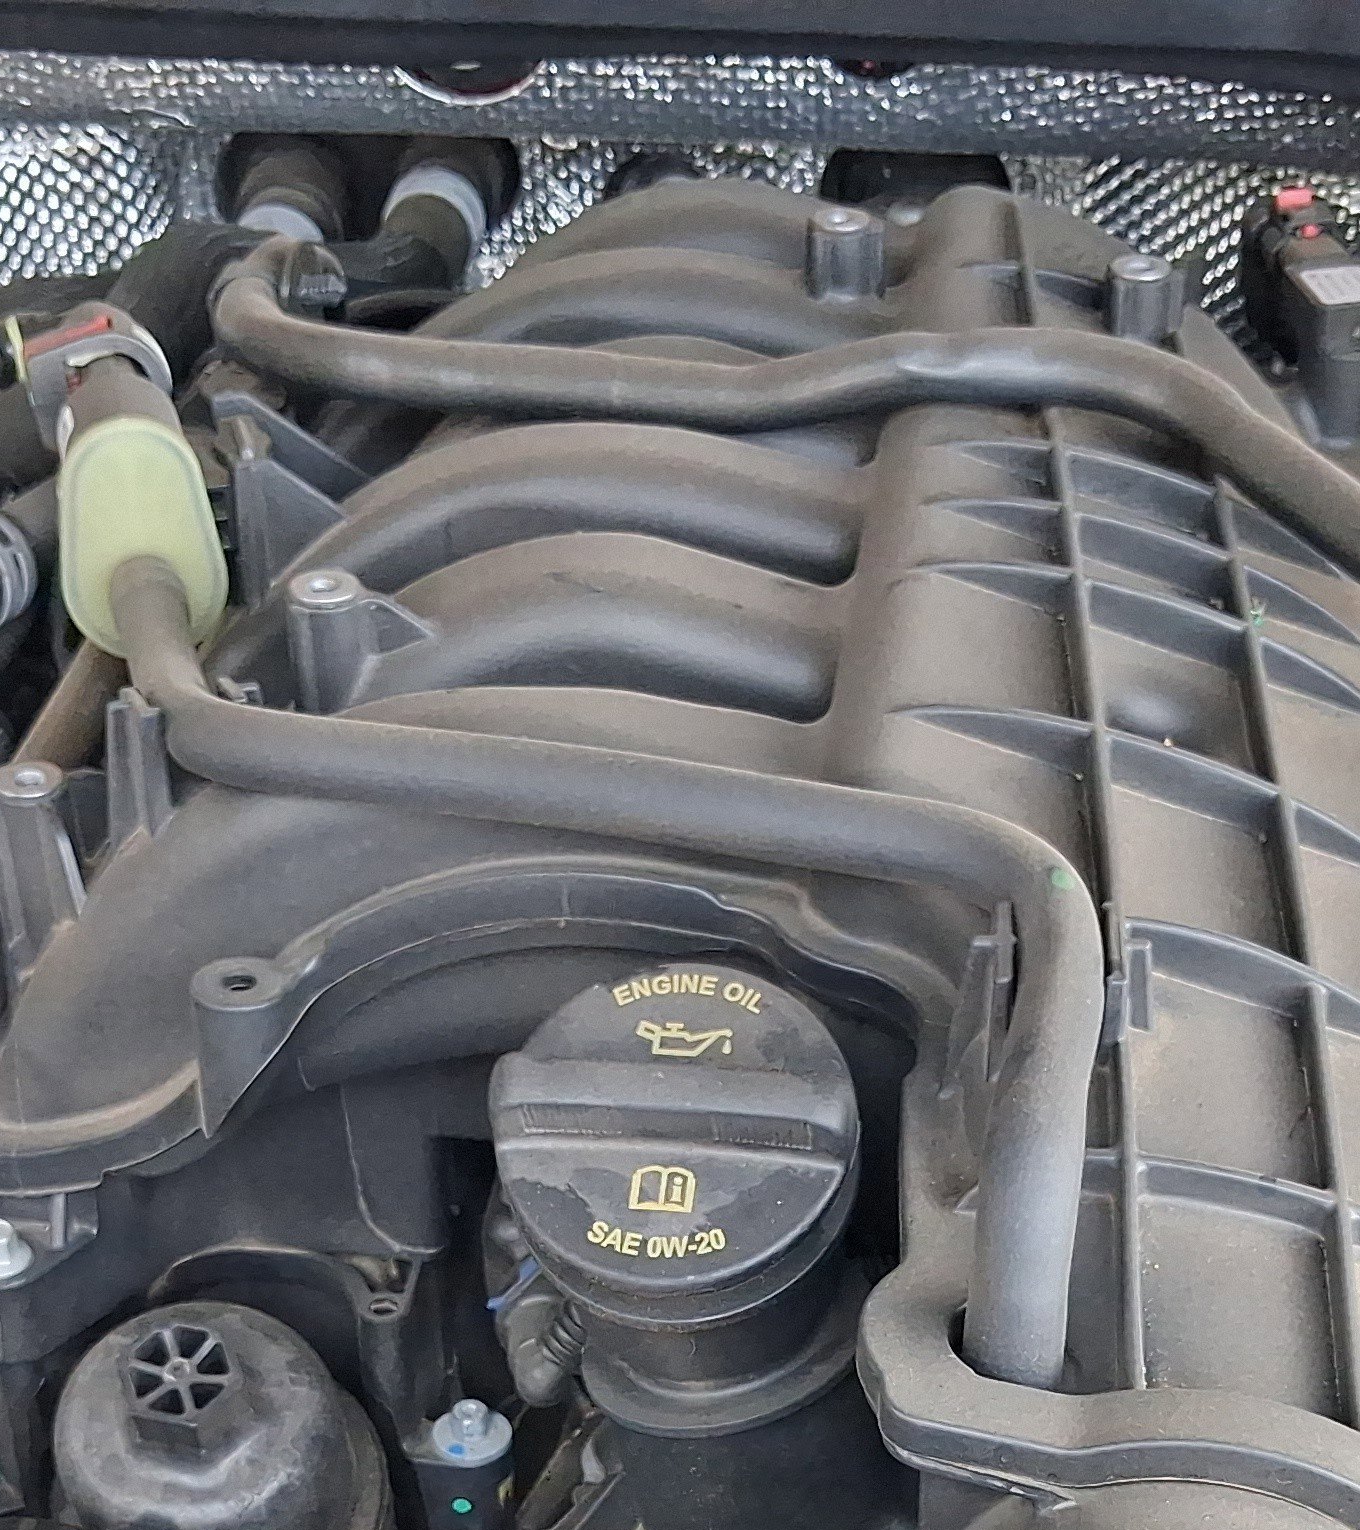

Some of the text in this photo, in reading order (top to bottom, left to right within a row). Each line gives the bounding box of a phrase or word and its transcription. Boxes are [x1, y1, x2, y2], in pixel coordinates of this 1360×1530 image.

[612, 973, 761, 1014] ENGINE OIL
[587, 1221, 727, 1259] SAE 0W-20
